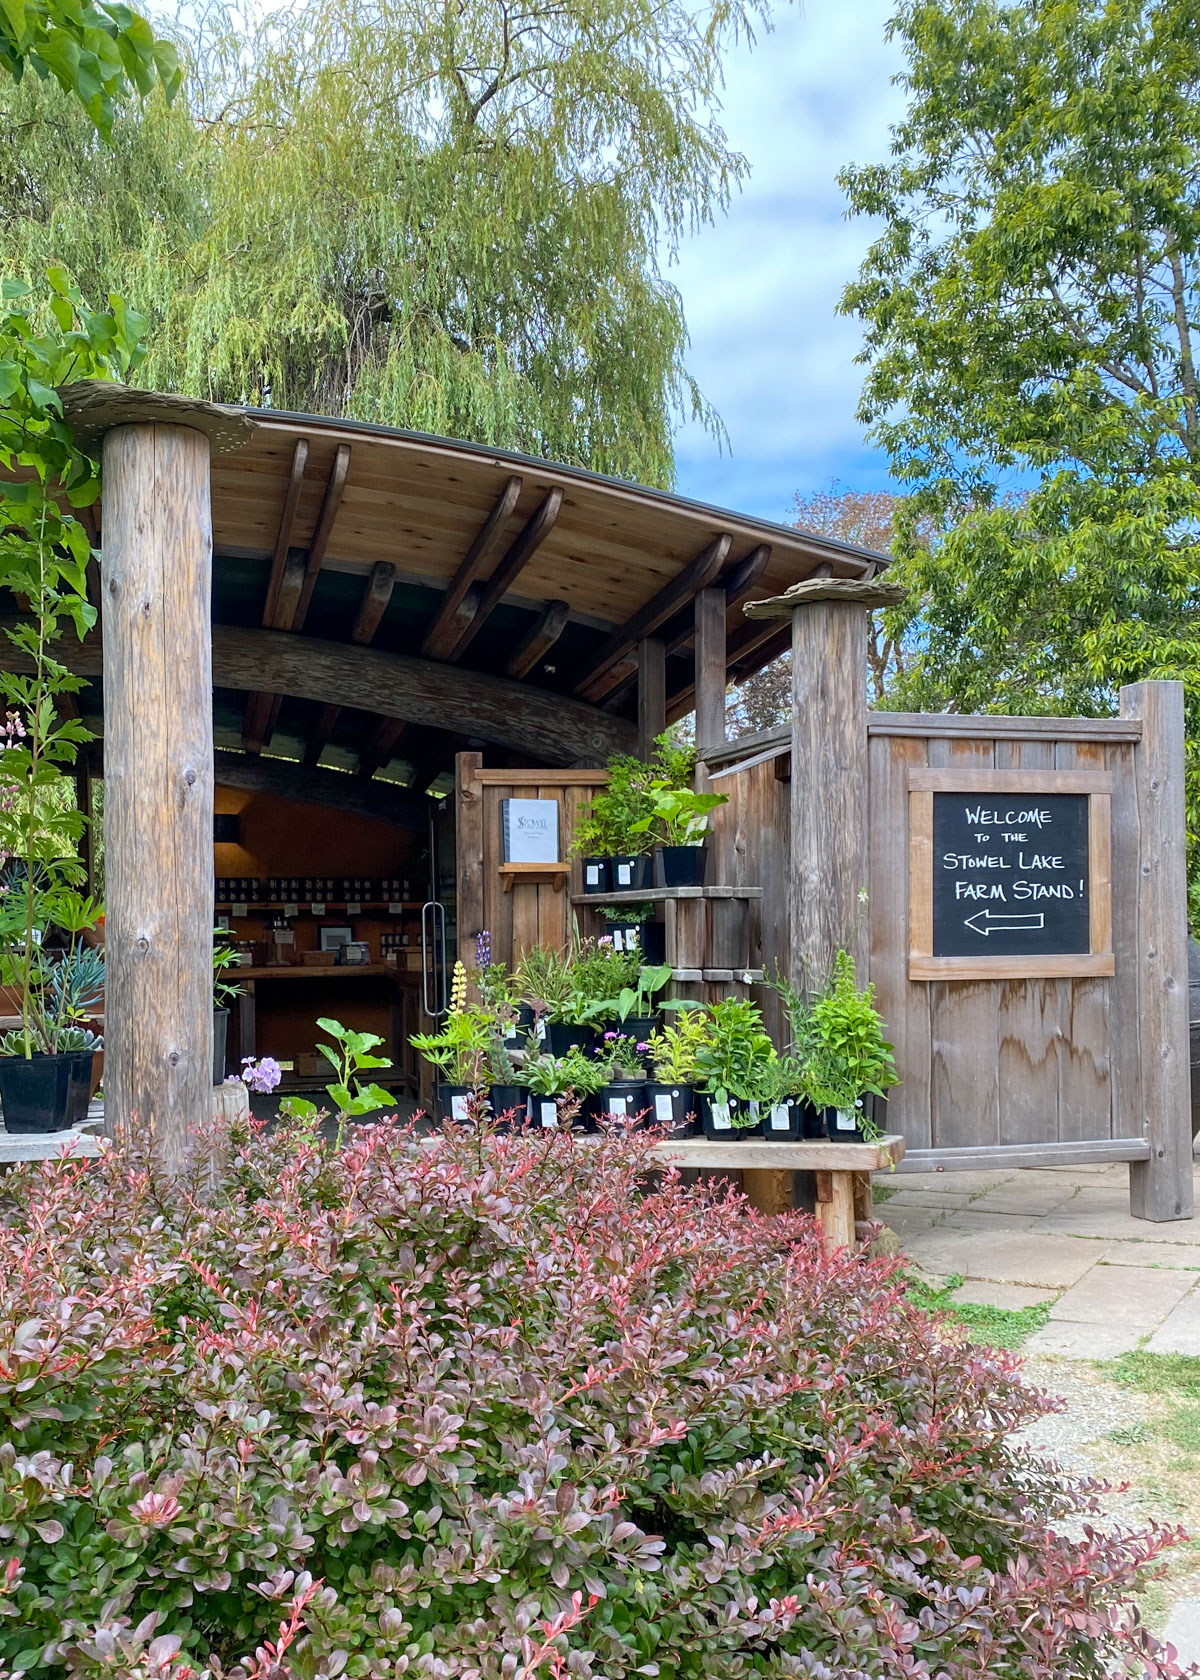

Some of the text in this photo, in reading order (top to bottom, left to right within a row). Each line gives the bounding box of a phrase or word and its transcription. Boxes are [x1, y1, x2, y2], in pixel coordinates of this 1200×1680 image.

[965, 805, 1052, 829] WELCOME
[1001, 833, 1028, 843] THE
[943, 852, 1065, 870] STOWEL LAKE
[955, 881, 1007, 902] FARM
